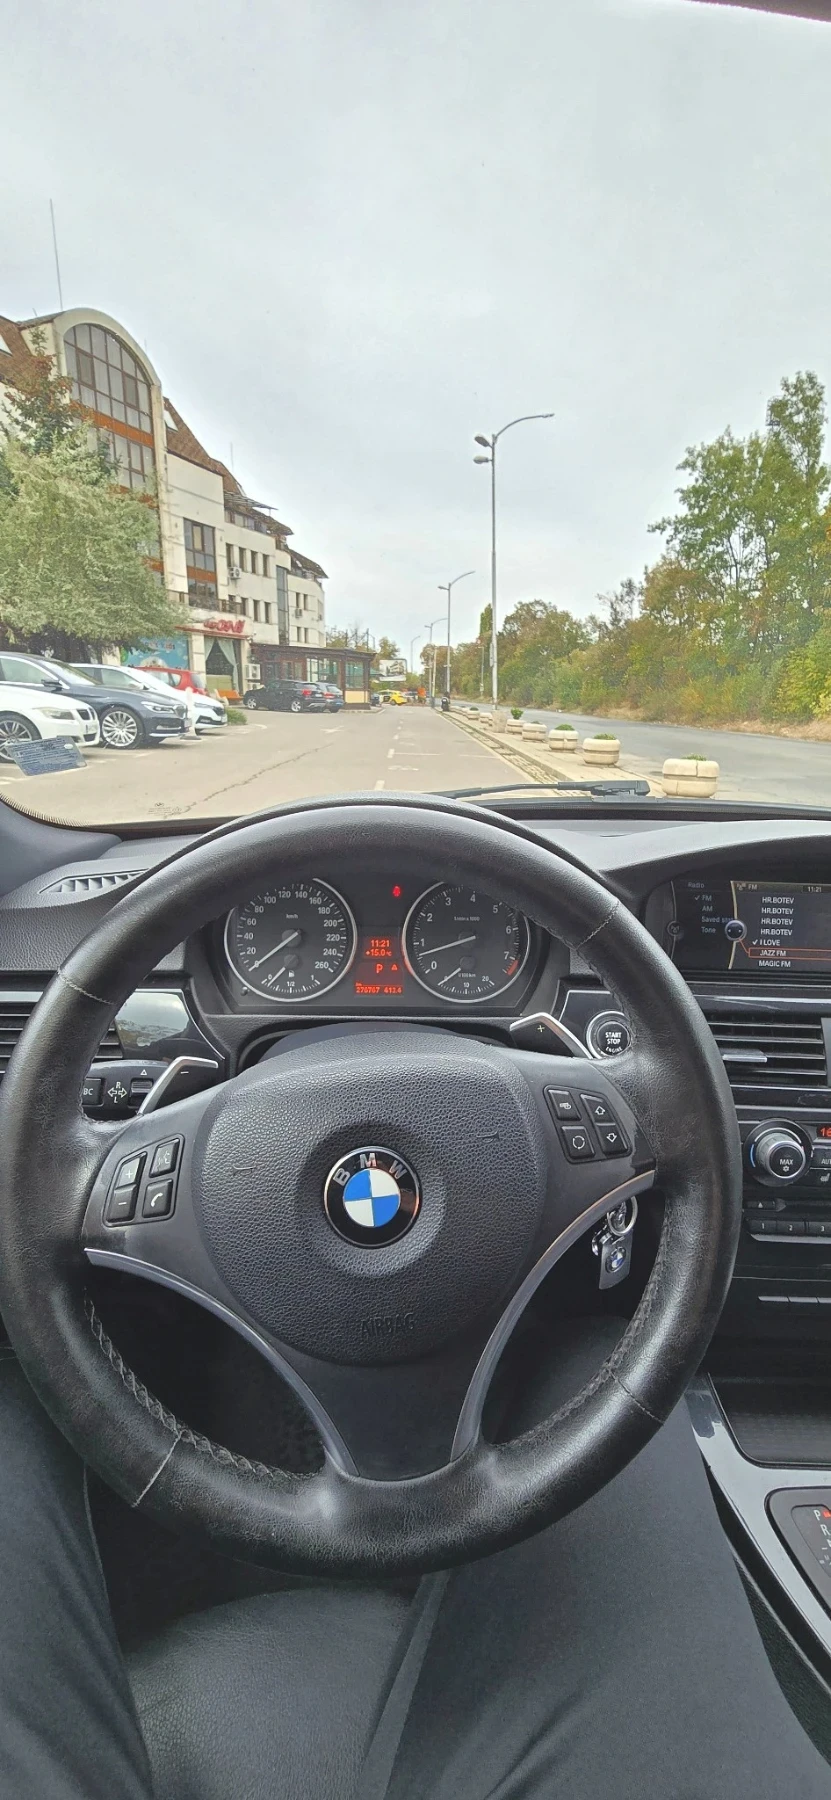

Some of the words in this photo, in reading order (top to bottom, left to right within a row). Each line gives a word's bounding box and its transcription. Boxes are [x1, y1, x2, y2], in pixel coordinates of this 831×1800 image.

[445, 897, 451, 906] 3
[470, 894, 476, 902] 4
[493, 905, 498, 913] 5
[427, 913, 433, 922] 2
[506, 926, 511, 934] 6
[504, 952, 510, 960] 7
[376, 964, 383, 974] P
[431, 961, 437, 970] 0
[332, 1152, 408, 1187] BMW
[813, 1510, 821, 1521] P
[820, 1524, 831, 1536] R
